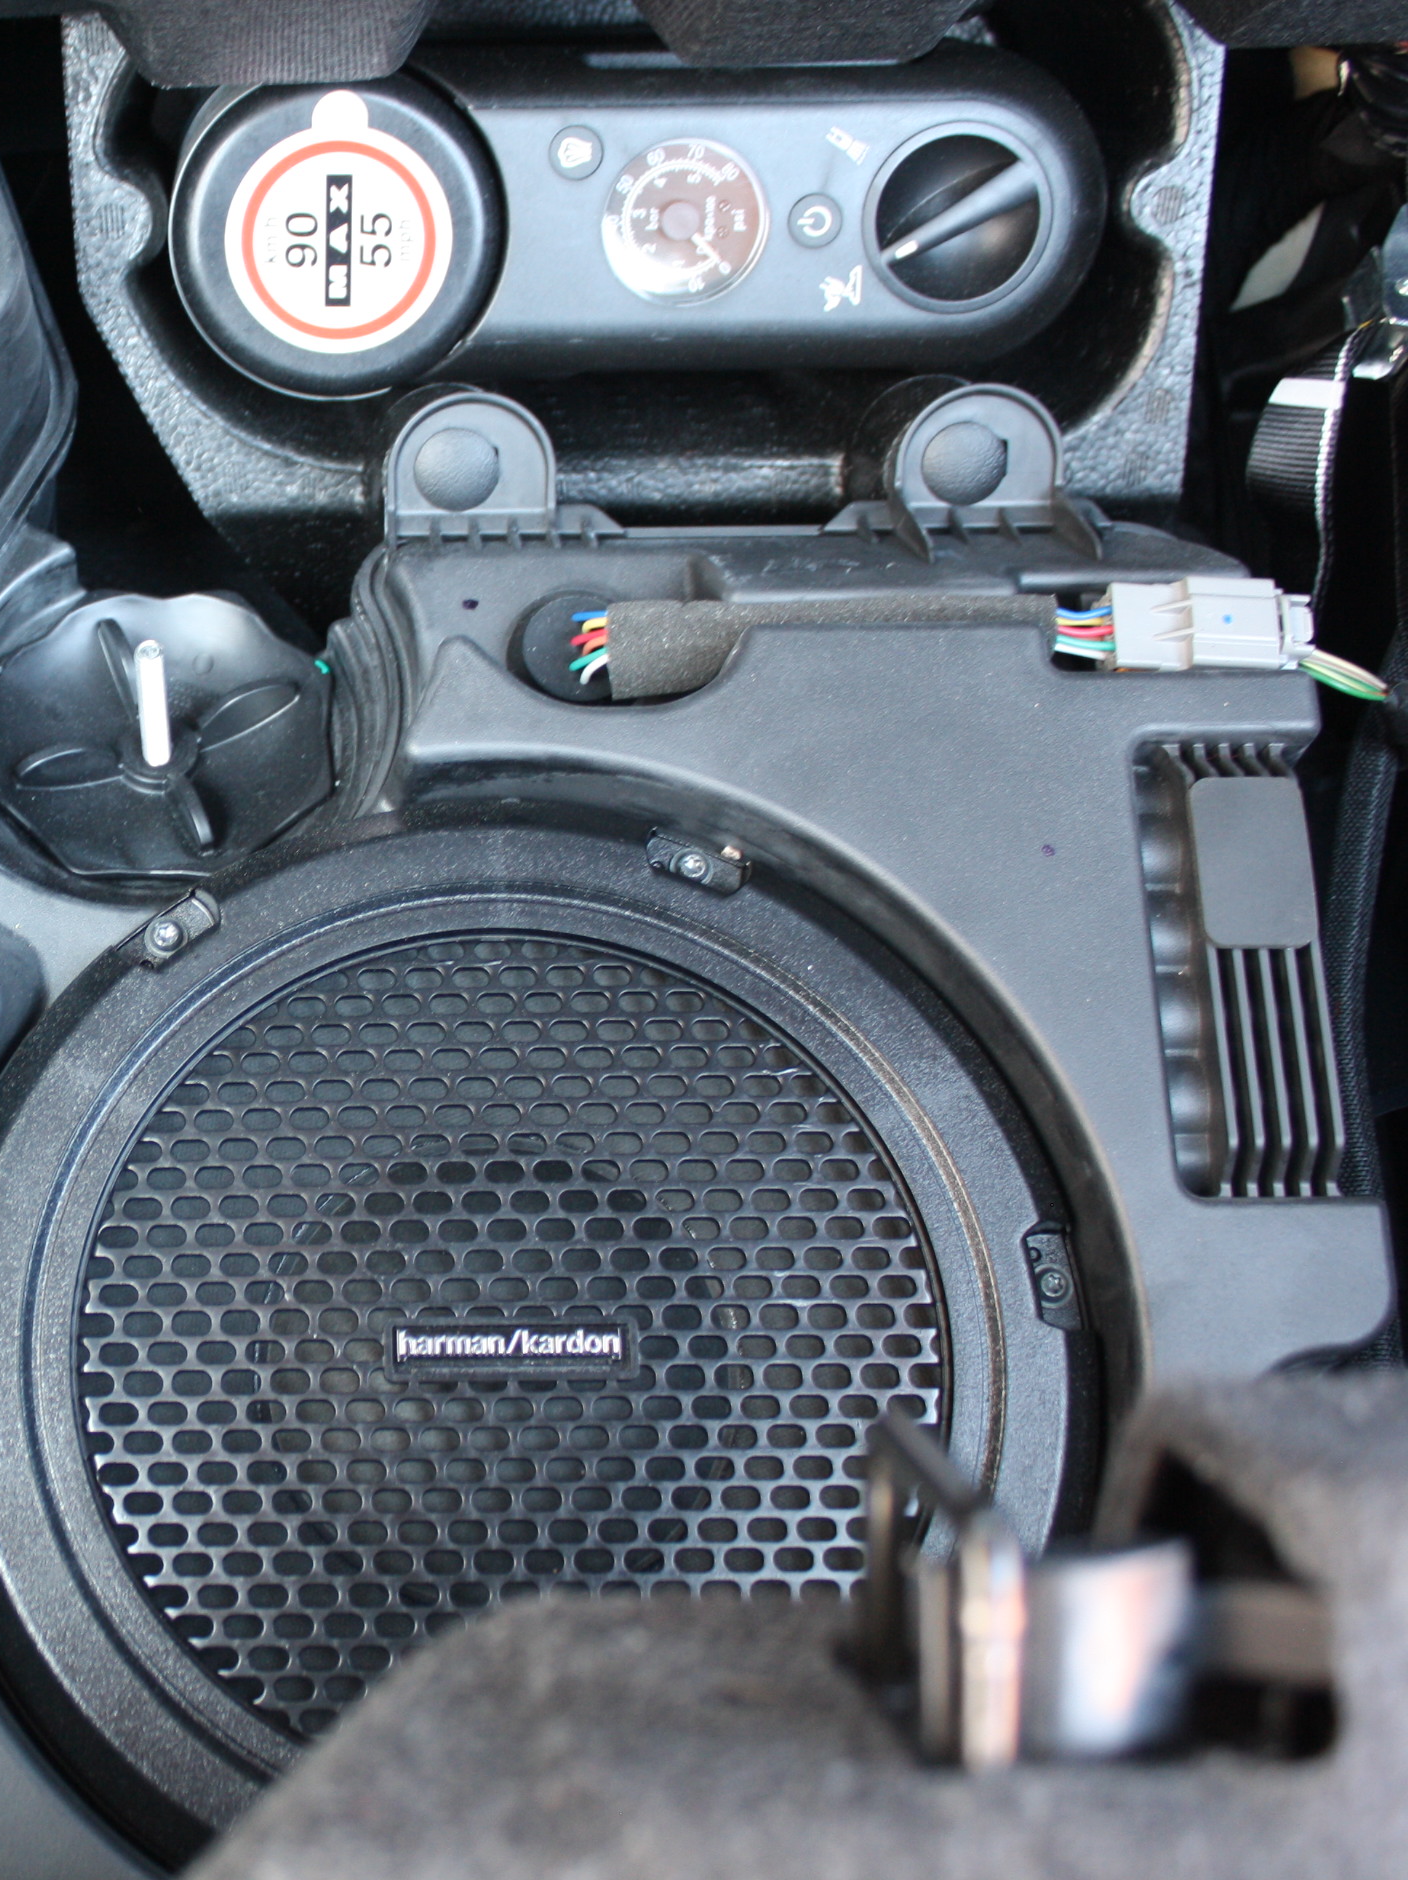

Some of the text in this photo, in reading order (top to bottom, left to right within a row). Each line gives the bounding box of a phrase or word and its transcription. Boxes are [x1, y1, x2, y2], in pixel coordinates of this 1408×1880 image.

[285, 212, 318, 268] 90
[328, 183, 349, 299] MAX
[359, 212, 392, 268] 55
[397, 1329, 621, 1356] harman/kardon
